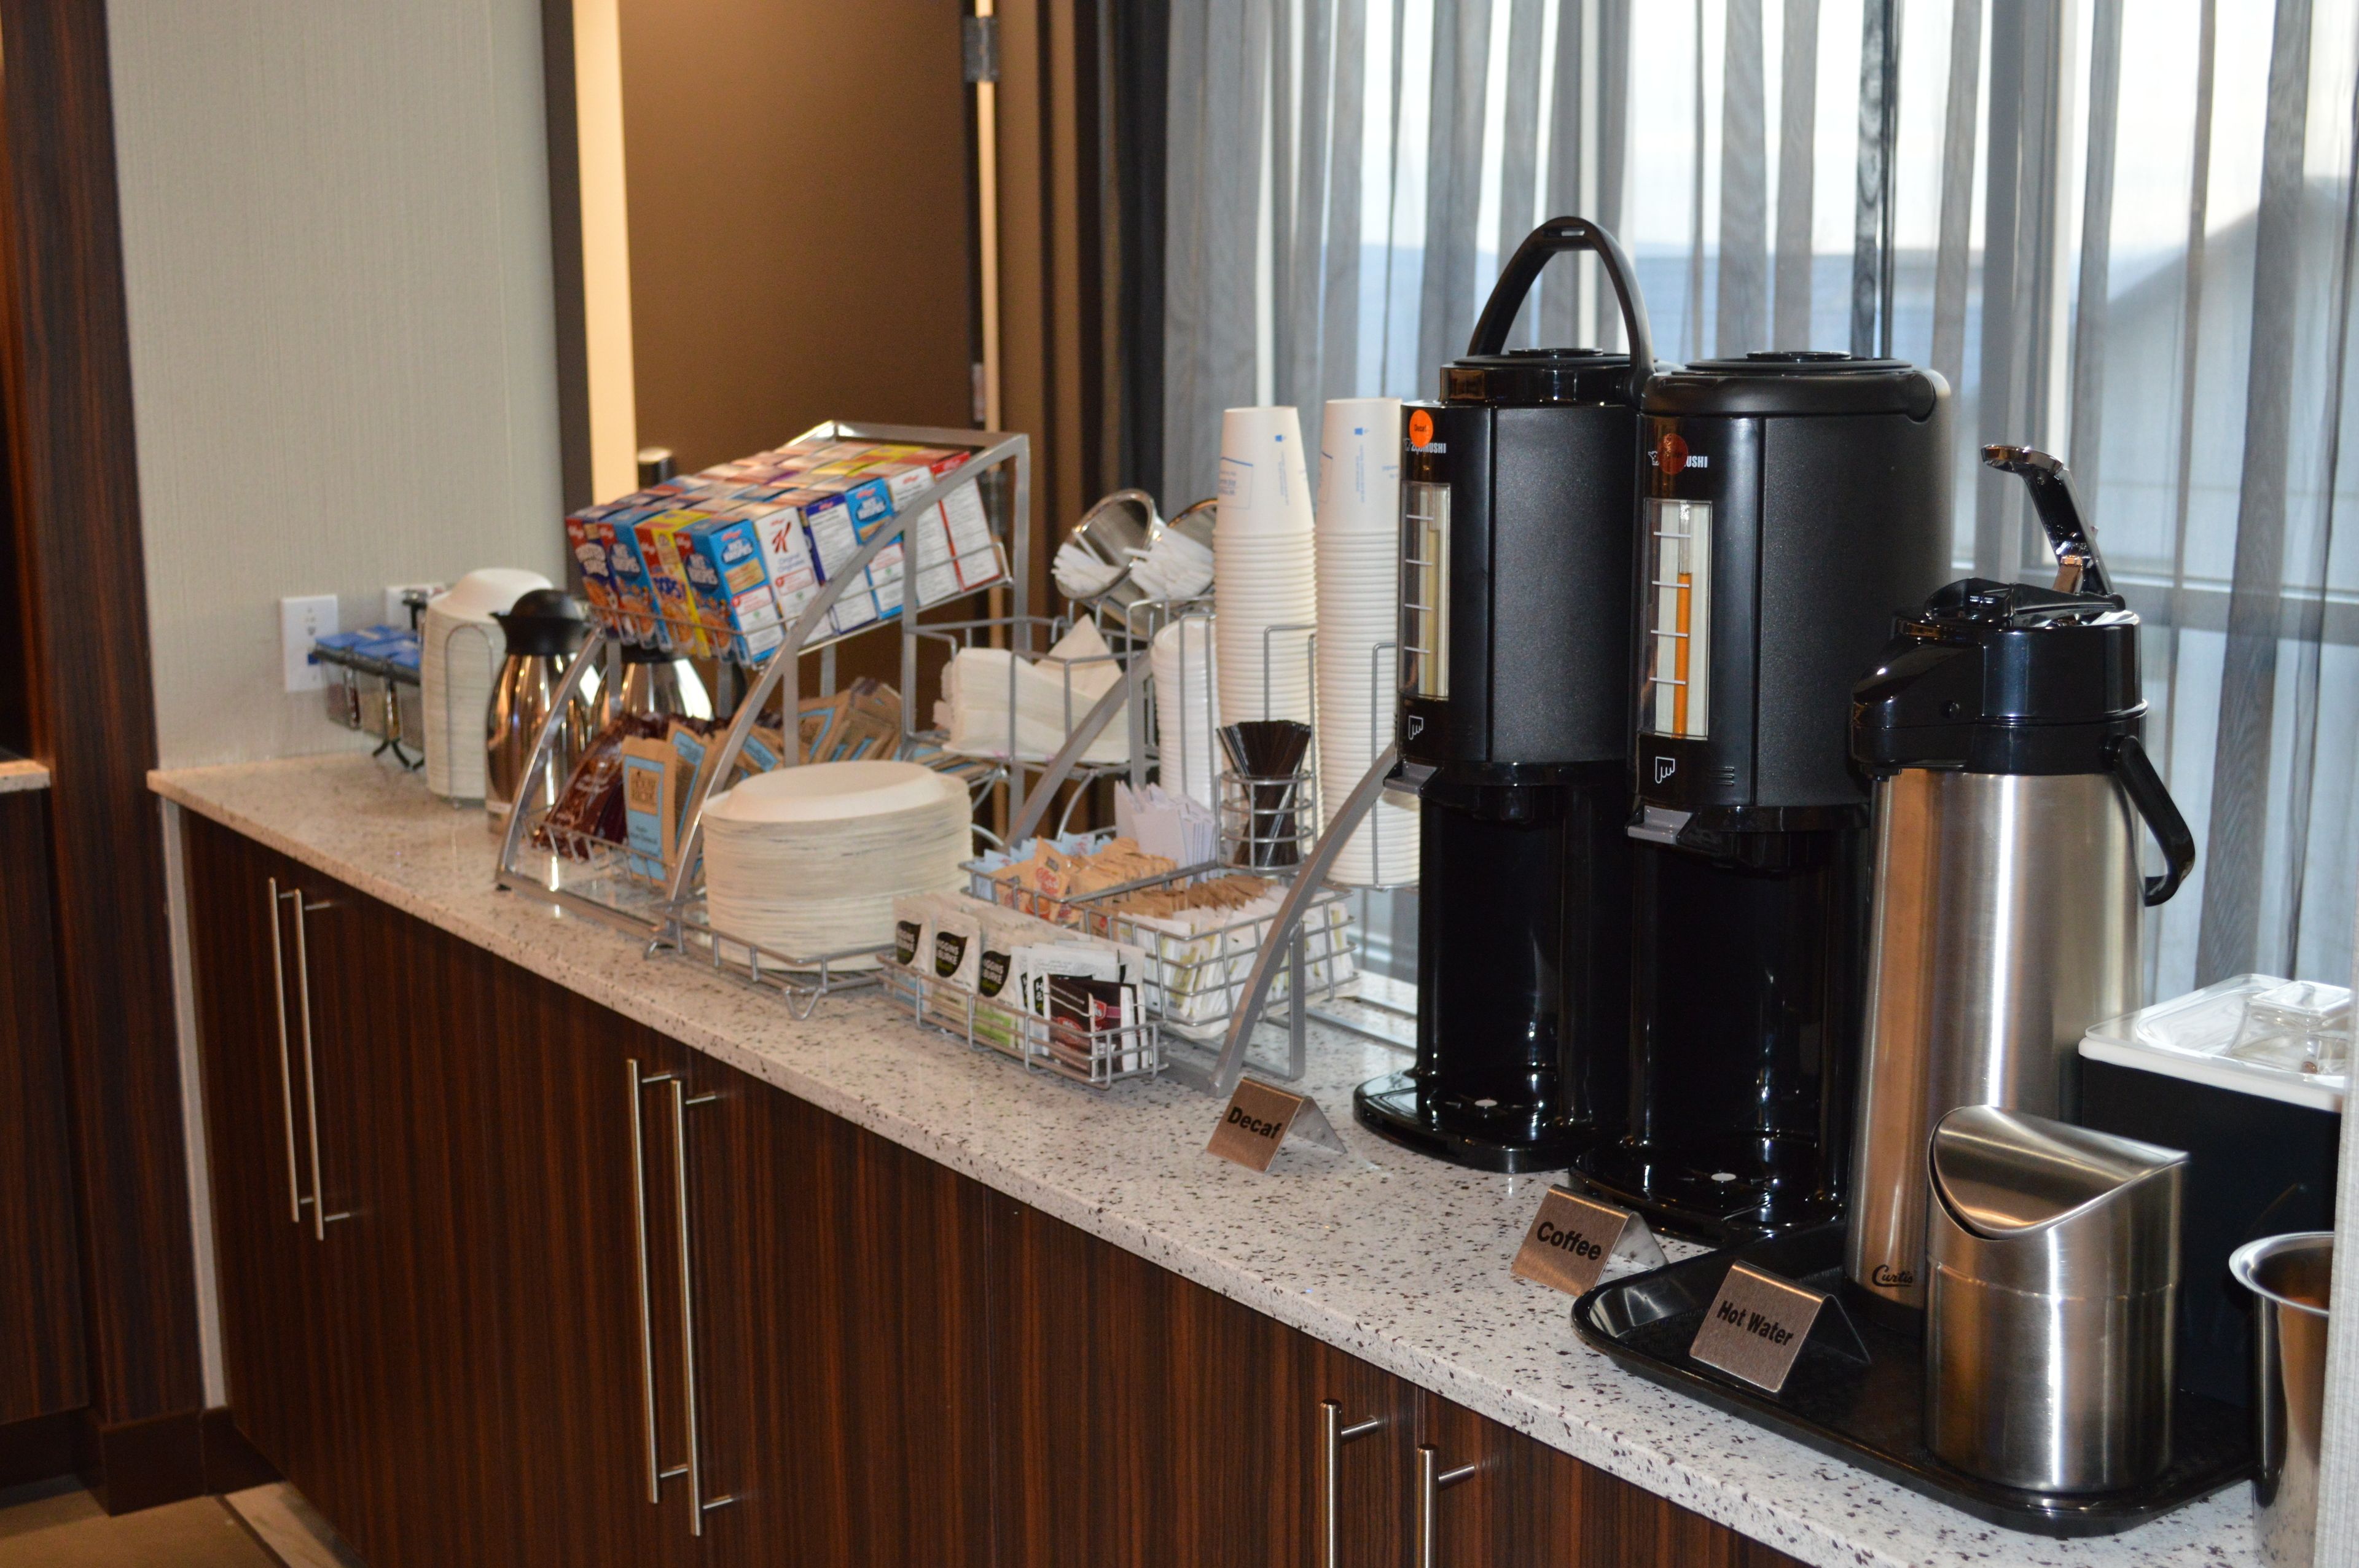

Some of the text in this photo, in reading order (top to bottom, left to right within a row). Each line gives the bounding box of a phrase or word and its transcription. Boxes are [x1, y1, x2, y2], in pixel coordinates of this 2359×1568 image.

[772, 521, 792, 553] K
[1227, 1106, 1282, 1139] Decaf
[1537, 1221, 1602, 1260] Coffee
[1872, 1264, 1913, 1287] Curtis
[1716, 1300, 1794, 1346] Hot Water
